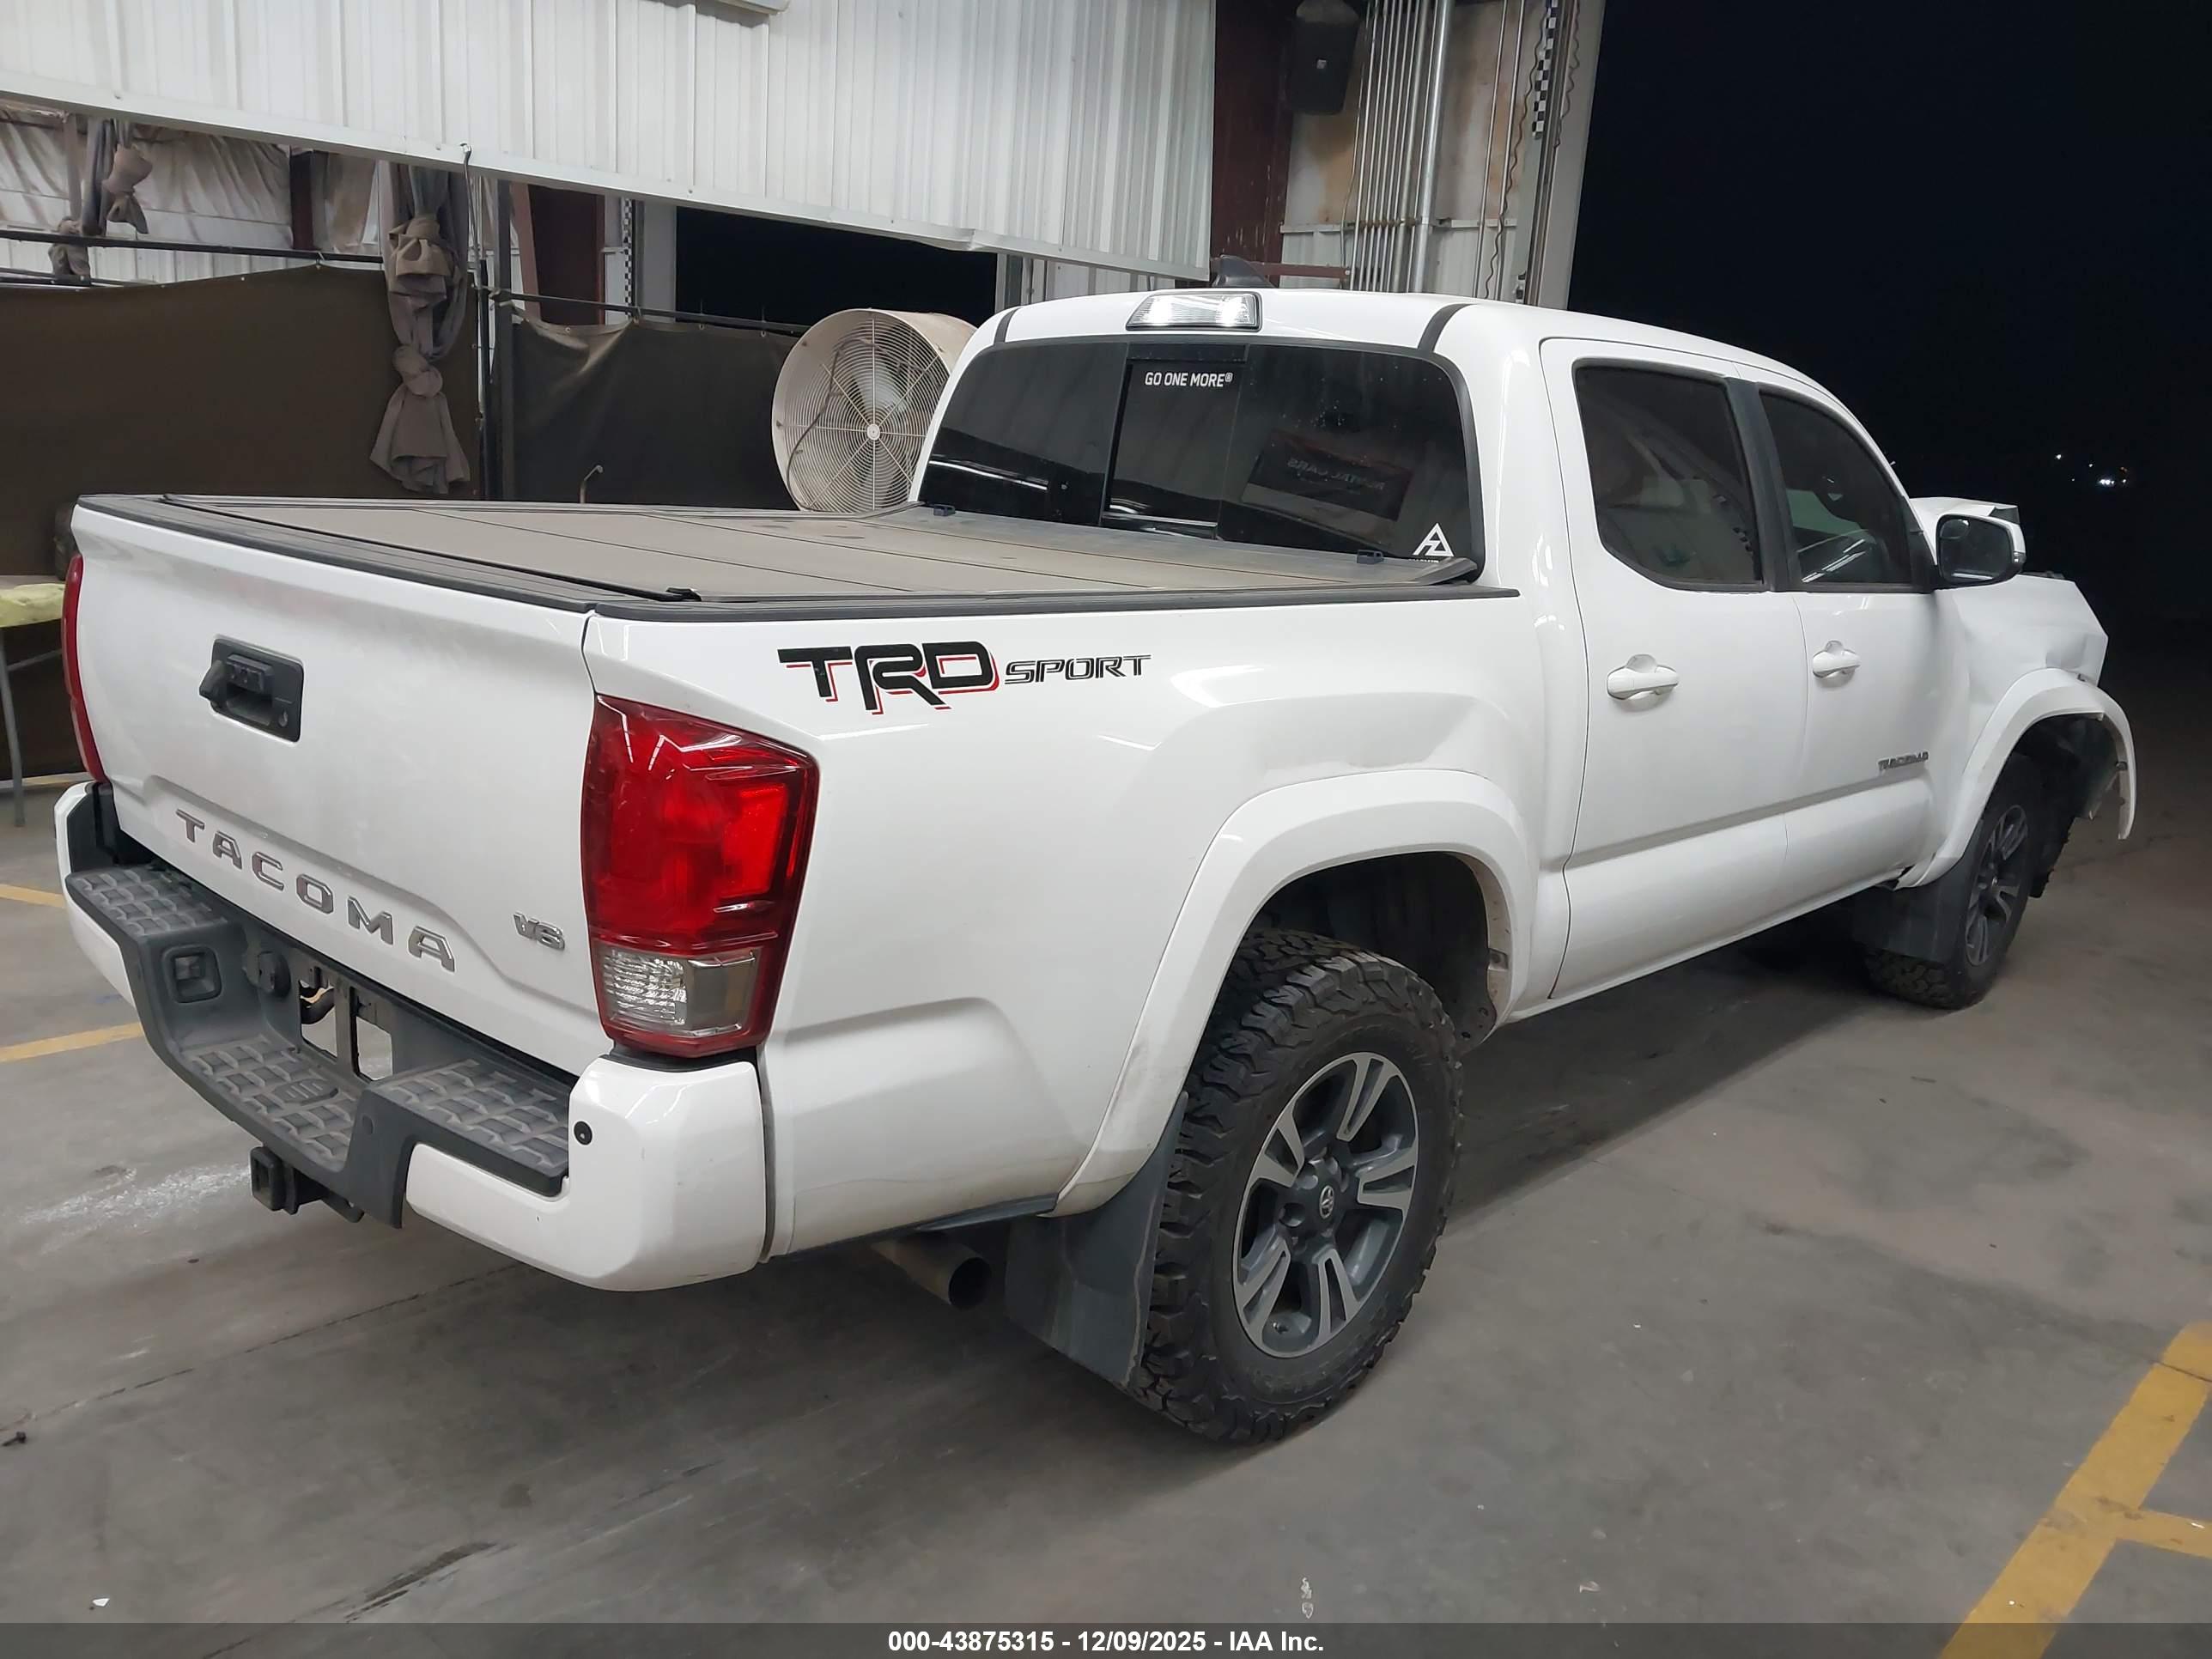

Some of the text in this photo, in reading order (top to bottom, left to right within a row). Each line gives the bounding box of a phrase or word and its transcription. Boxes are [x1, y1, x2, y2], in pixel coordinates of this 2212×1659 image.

[1145, 372, 1162, 386] GO
[1164, 372, 1188, 386] ONE
[777, 641, 1152, 714] TRD SPORT
[175, 808, 456, 973] TACOMA
[513, 911, 566, 951] V6
